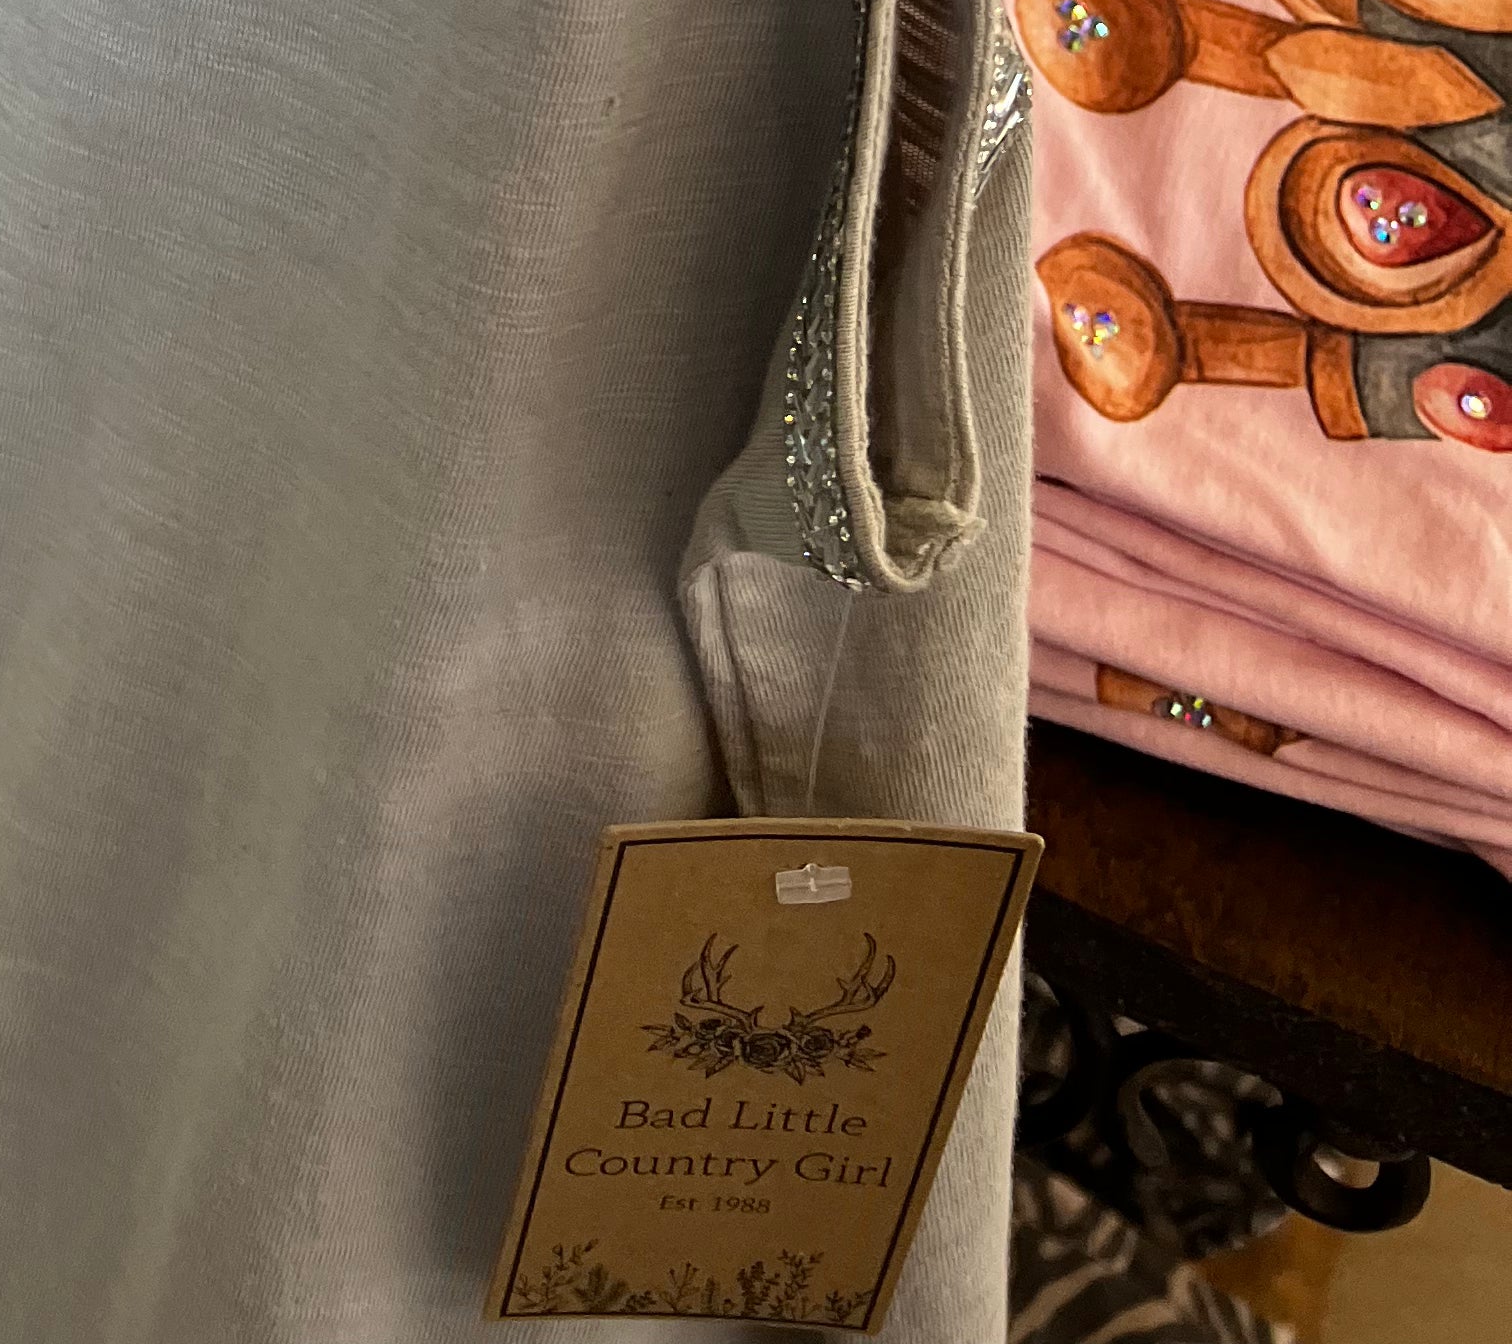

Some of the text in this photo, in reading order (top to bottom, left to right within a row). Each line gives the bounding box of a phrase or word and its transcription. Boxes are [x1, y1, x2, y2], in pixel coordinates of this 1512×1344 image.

[614, 1097, 868, 1137] Bad Little
[564, 1148, 893, 1188] Country Girl
[659, 1195, 772, 1214] Est 1988
